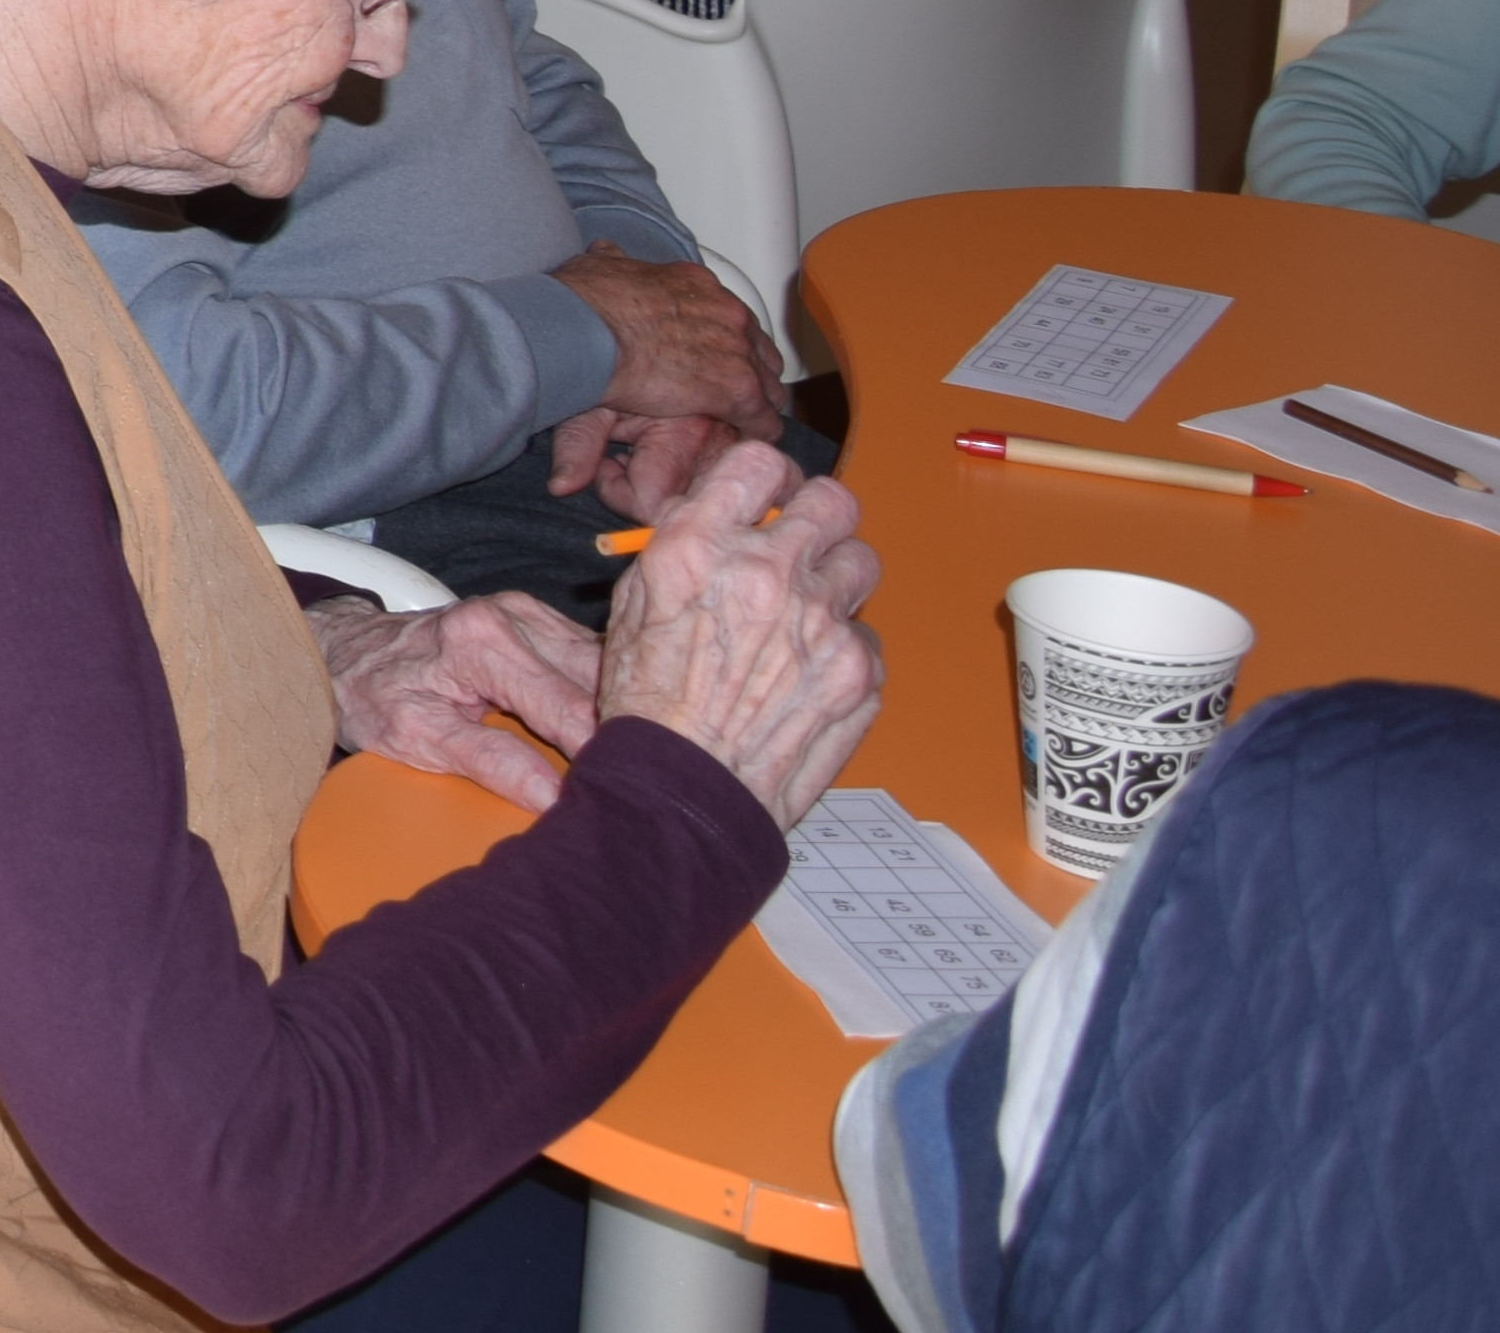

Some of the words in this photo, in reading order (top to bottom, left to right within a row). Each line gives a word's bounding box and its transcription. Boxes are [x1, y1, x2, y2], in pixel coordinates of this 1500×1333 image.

[814, 827, 840, 838] 14
[886, 898, 912, 912] 42
[933, 949, 963, 963] 65
[960, 976, 989, 990] 75
[831, 898, 856, 912] 46
[878, 948, 907, 963] 67
[868, 827, 893, 838] 13
[888, 848, 916, 861] 21
[963, 923, 992, 937] 54
[989, 949, 1018, 963] 62
